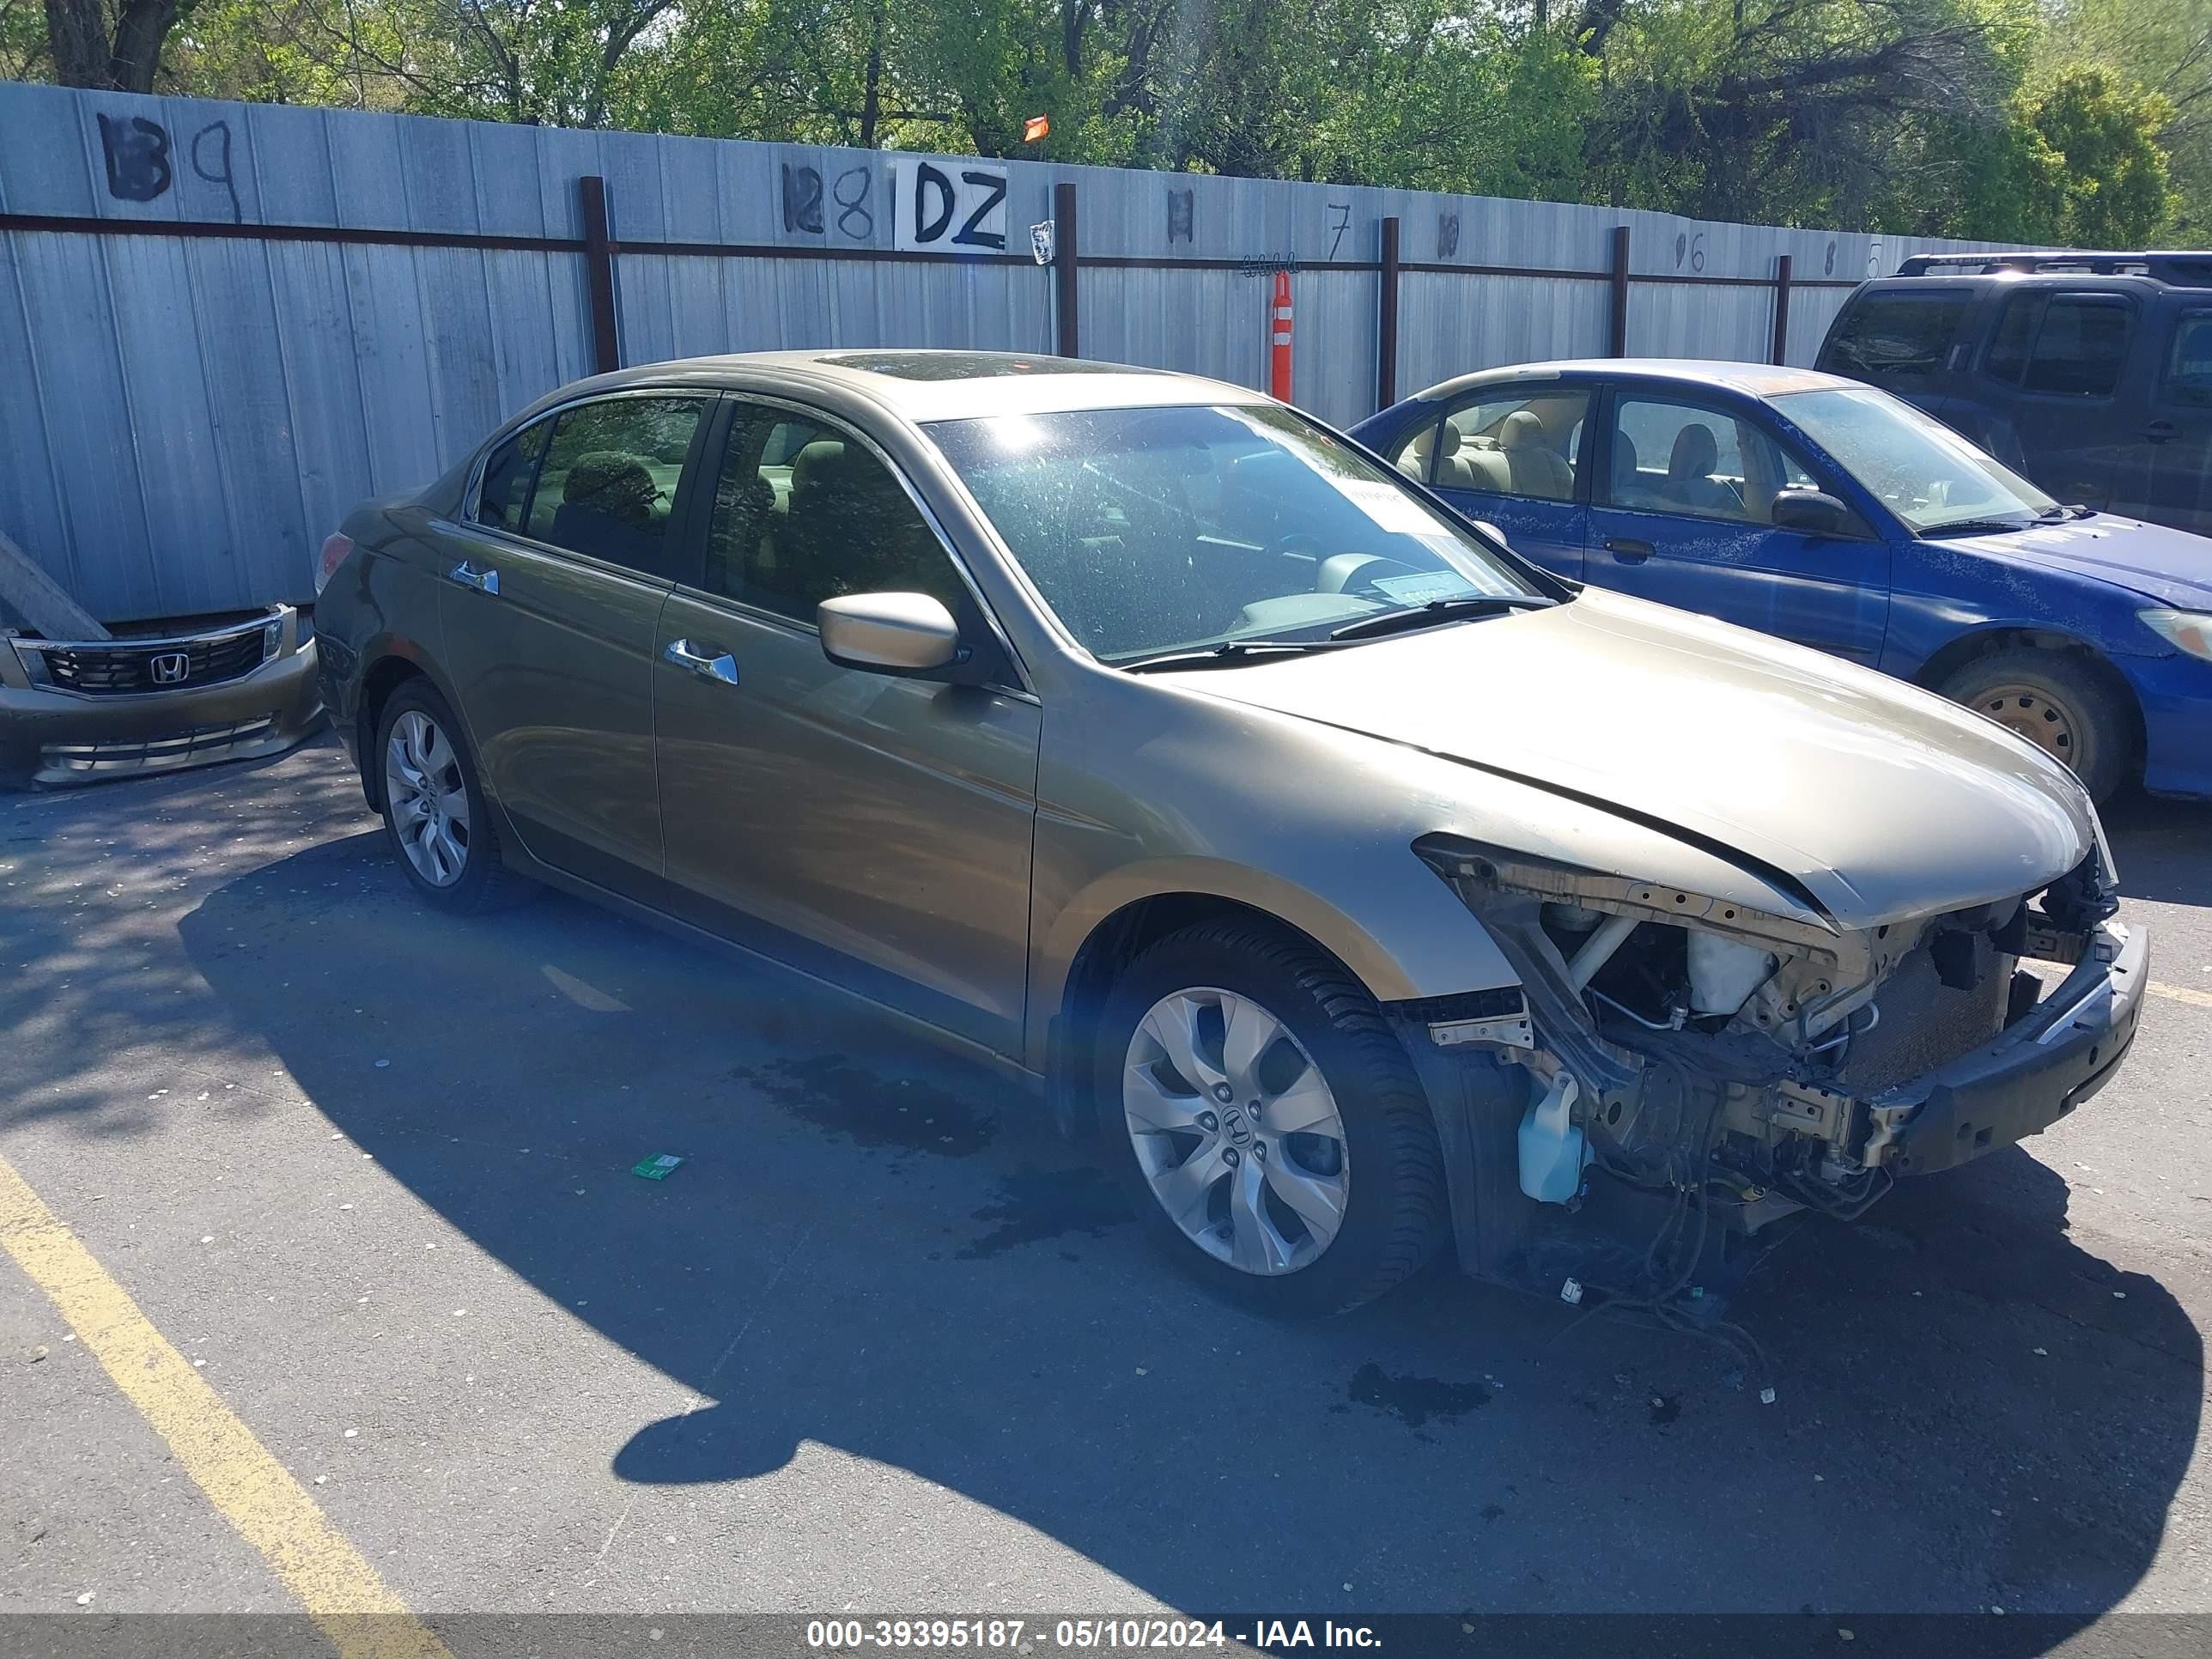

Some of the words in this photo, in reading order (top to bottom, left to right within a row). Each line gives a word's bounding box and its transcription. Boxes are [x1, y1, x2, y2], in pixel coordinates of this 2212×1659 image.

[915, 161, 1006, 250] DZ
[1328, 204, 1351, 262] 7
[1867, 242, 1881, 279] 5
